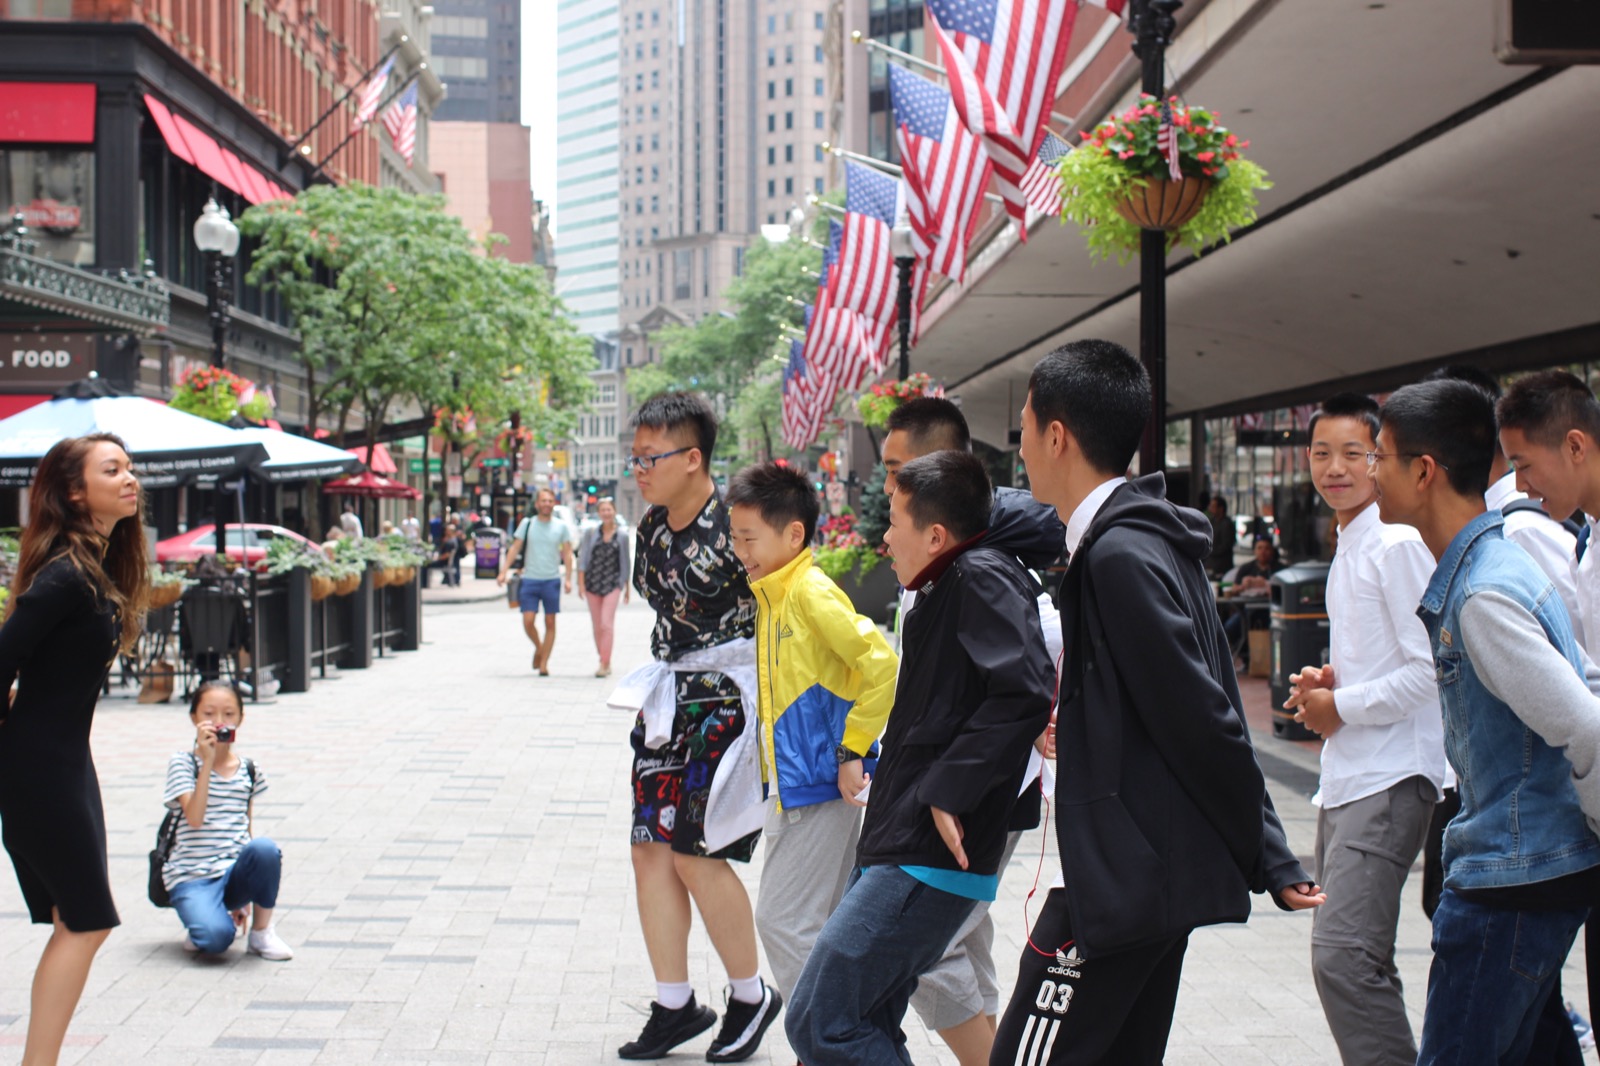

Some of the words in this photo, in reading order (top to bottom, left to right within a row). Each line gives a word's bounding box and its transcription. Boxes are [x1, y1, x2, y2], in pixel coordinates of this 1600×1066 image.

[12, 350, 70, 368] FOOD
[1047, 965, 1081, 978] adidas
[1035, 979, 1074, 1015] 03
